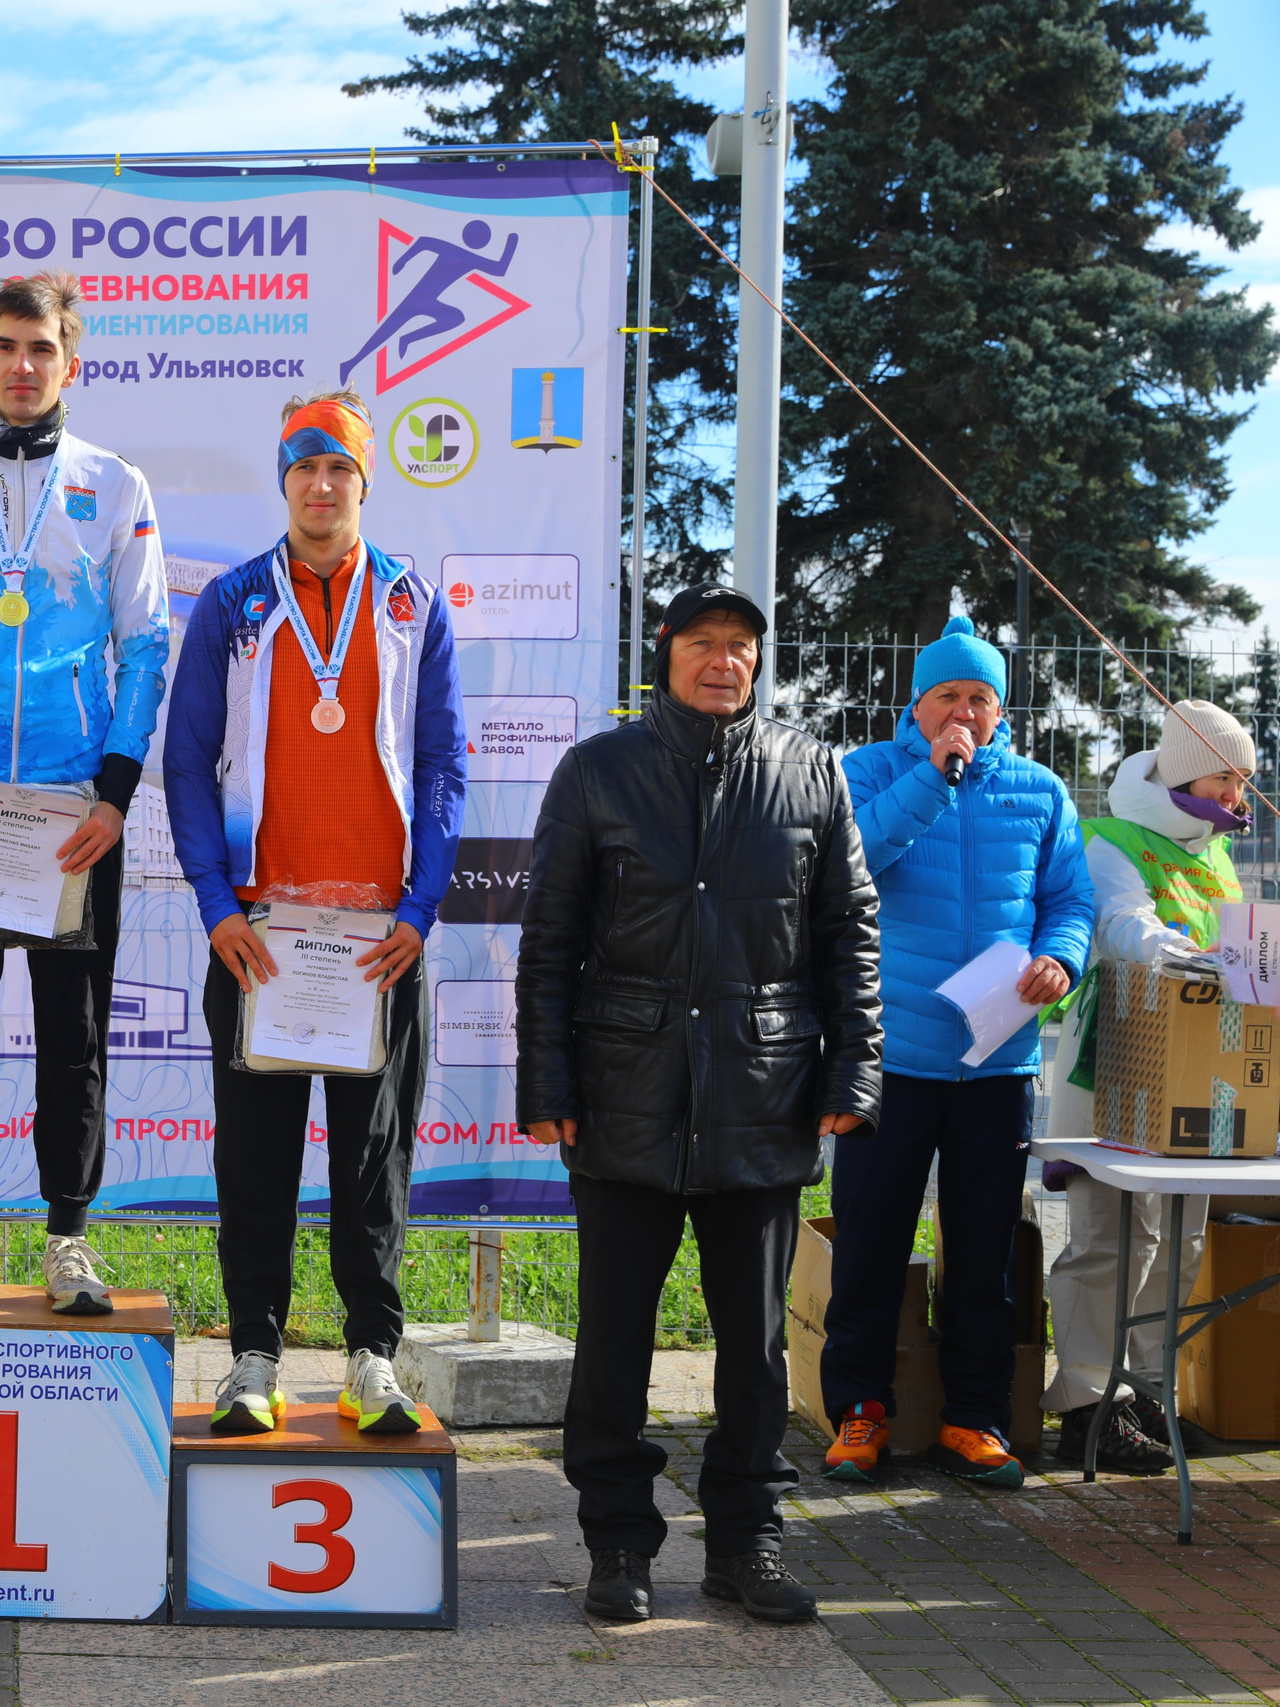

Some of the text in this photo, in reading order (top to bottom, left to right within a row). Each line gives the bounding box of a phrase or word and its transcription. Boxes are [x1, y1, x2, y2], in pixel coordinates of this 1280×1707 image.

[72, 216, 307, 259] РОССИИ
[4, 273, 308, 302] ЕВНОВАНИЯ
[147, 353, 305, 379] Ульяновск
[24, 510, 44, 552] МИНИСТЕРСТВО
[40, 488, 51, 510] СПОРТА
[48, 466, 59, 488] РОССИИ
[481, 578, 572, 601] azimut
[277, 575, 317, 660] МИНИСТЕРСТВО СПОРТА РОССИИ
[335, 574, 361, 658] МИНИСТЕРСТВО СПОРТА РОССИИ
[481, 607, 510, 615] ОТЕЛЬ
[127, 686, 139, 727] VICTORY
[481, 722, 544, 731] МЕТАЛЛО
[481, 733, 574, 743] ПРОФИЛЬНЫЙ
[481, 745, 525, 755] ЗАВОД
[2, 821, 34, 831] степень
[20, 842, 41, 851] МИХАИЛ
[449, 871, 530, 890] ARSWE
[294, 939, 352, 955] ДИПЛОМ
[310, 955, 342, 965] степень
[1259, 931, 1269, 983] ДИПЛОМ
[291, 970, 348, 982] ЛОГИНОВ ВЛАДИСЛАВ
[1252, 1070, 1262, 1078] 12
[1179, 1116, 1192, 1137] L
[30, 1385, 119, 1402] ОБЛАСТИ
[265, 1477, 356, 1594] 3
